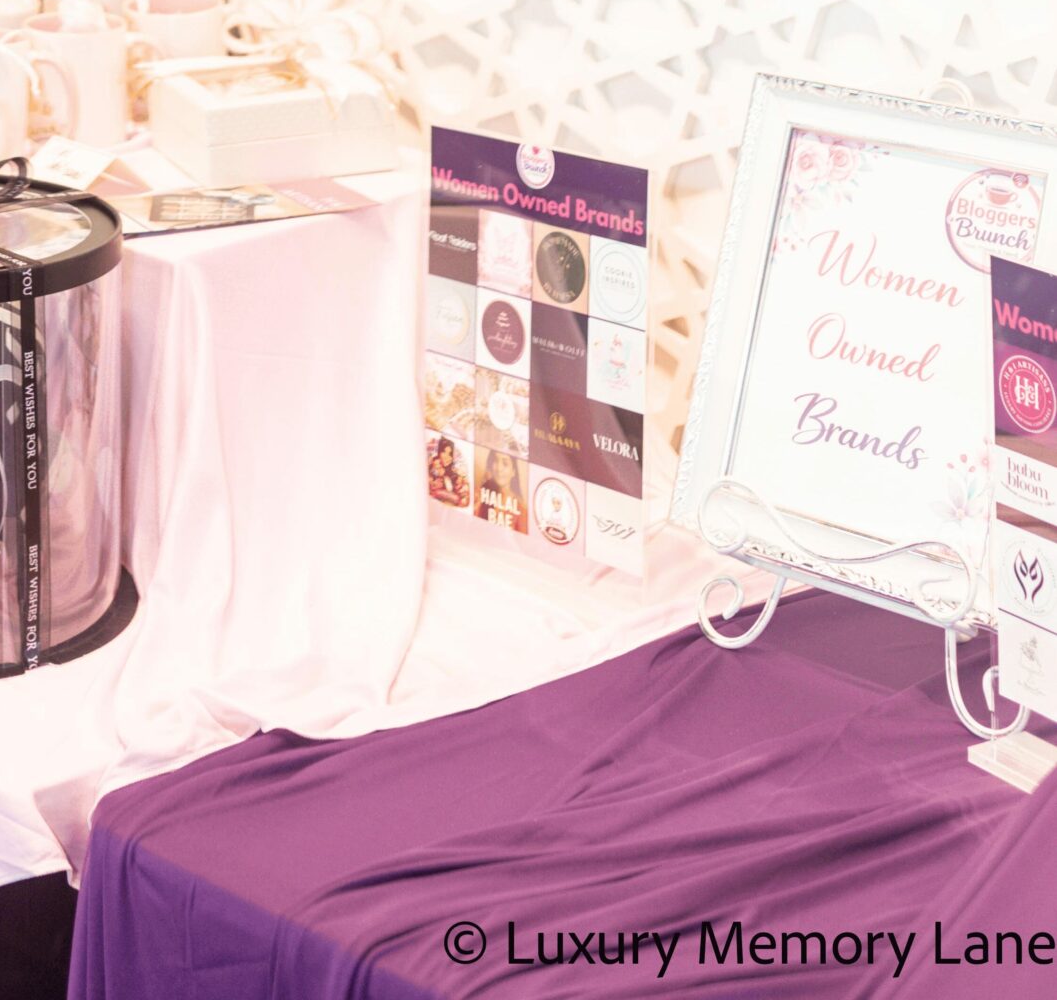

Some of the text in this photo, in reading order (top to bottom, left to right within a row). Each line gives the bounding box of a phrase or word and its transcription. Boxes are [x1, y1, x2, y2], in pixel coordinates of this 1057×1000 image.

[431, 166, 644, 236] Women Owned Brands
[956, 197, 1036, 230] Bloggers
[955, 216, 1031, 251] Brunch
[22, 268, 32, 296] YOU
[808, 230, 965, 308] Women
[994, 298, 1057, 344] Wom
[807, 312, 941, 383] Owned
[24, 351, 37, 490] BEST WISHES FOR YOU
[791, 392, 929, 470] Brands
[592, 433, 640, 461] VELORA
[1007, 456, 1042, 482] bubu
[1007, 471, 1048, 500] bloom
[481, 487, 521, 515] HALAL
[488, 508, 514, 531] BAE
[28, 544, 39, 573] BEST
[27, 576, 38, 623] WISHES
[26, 625, 37, 651] FOR
